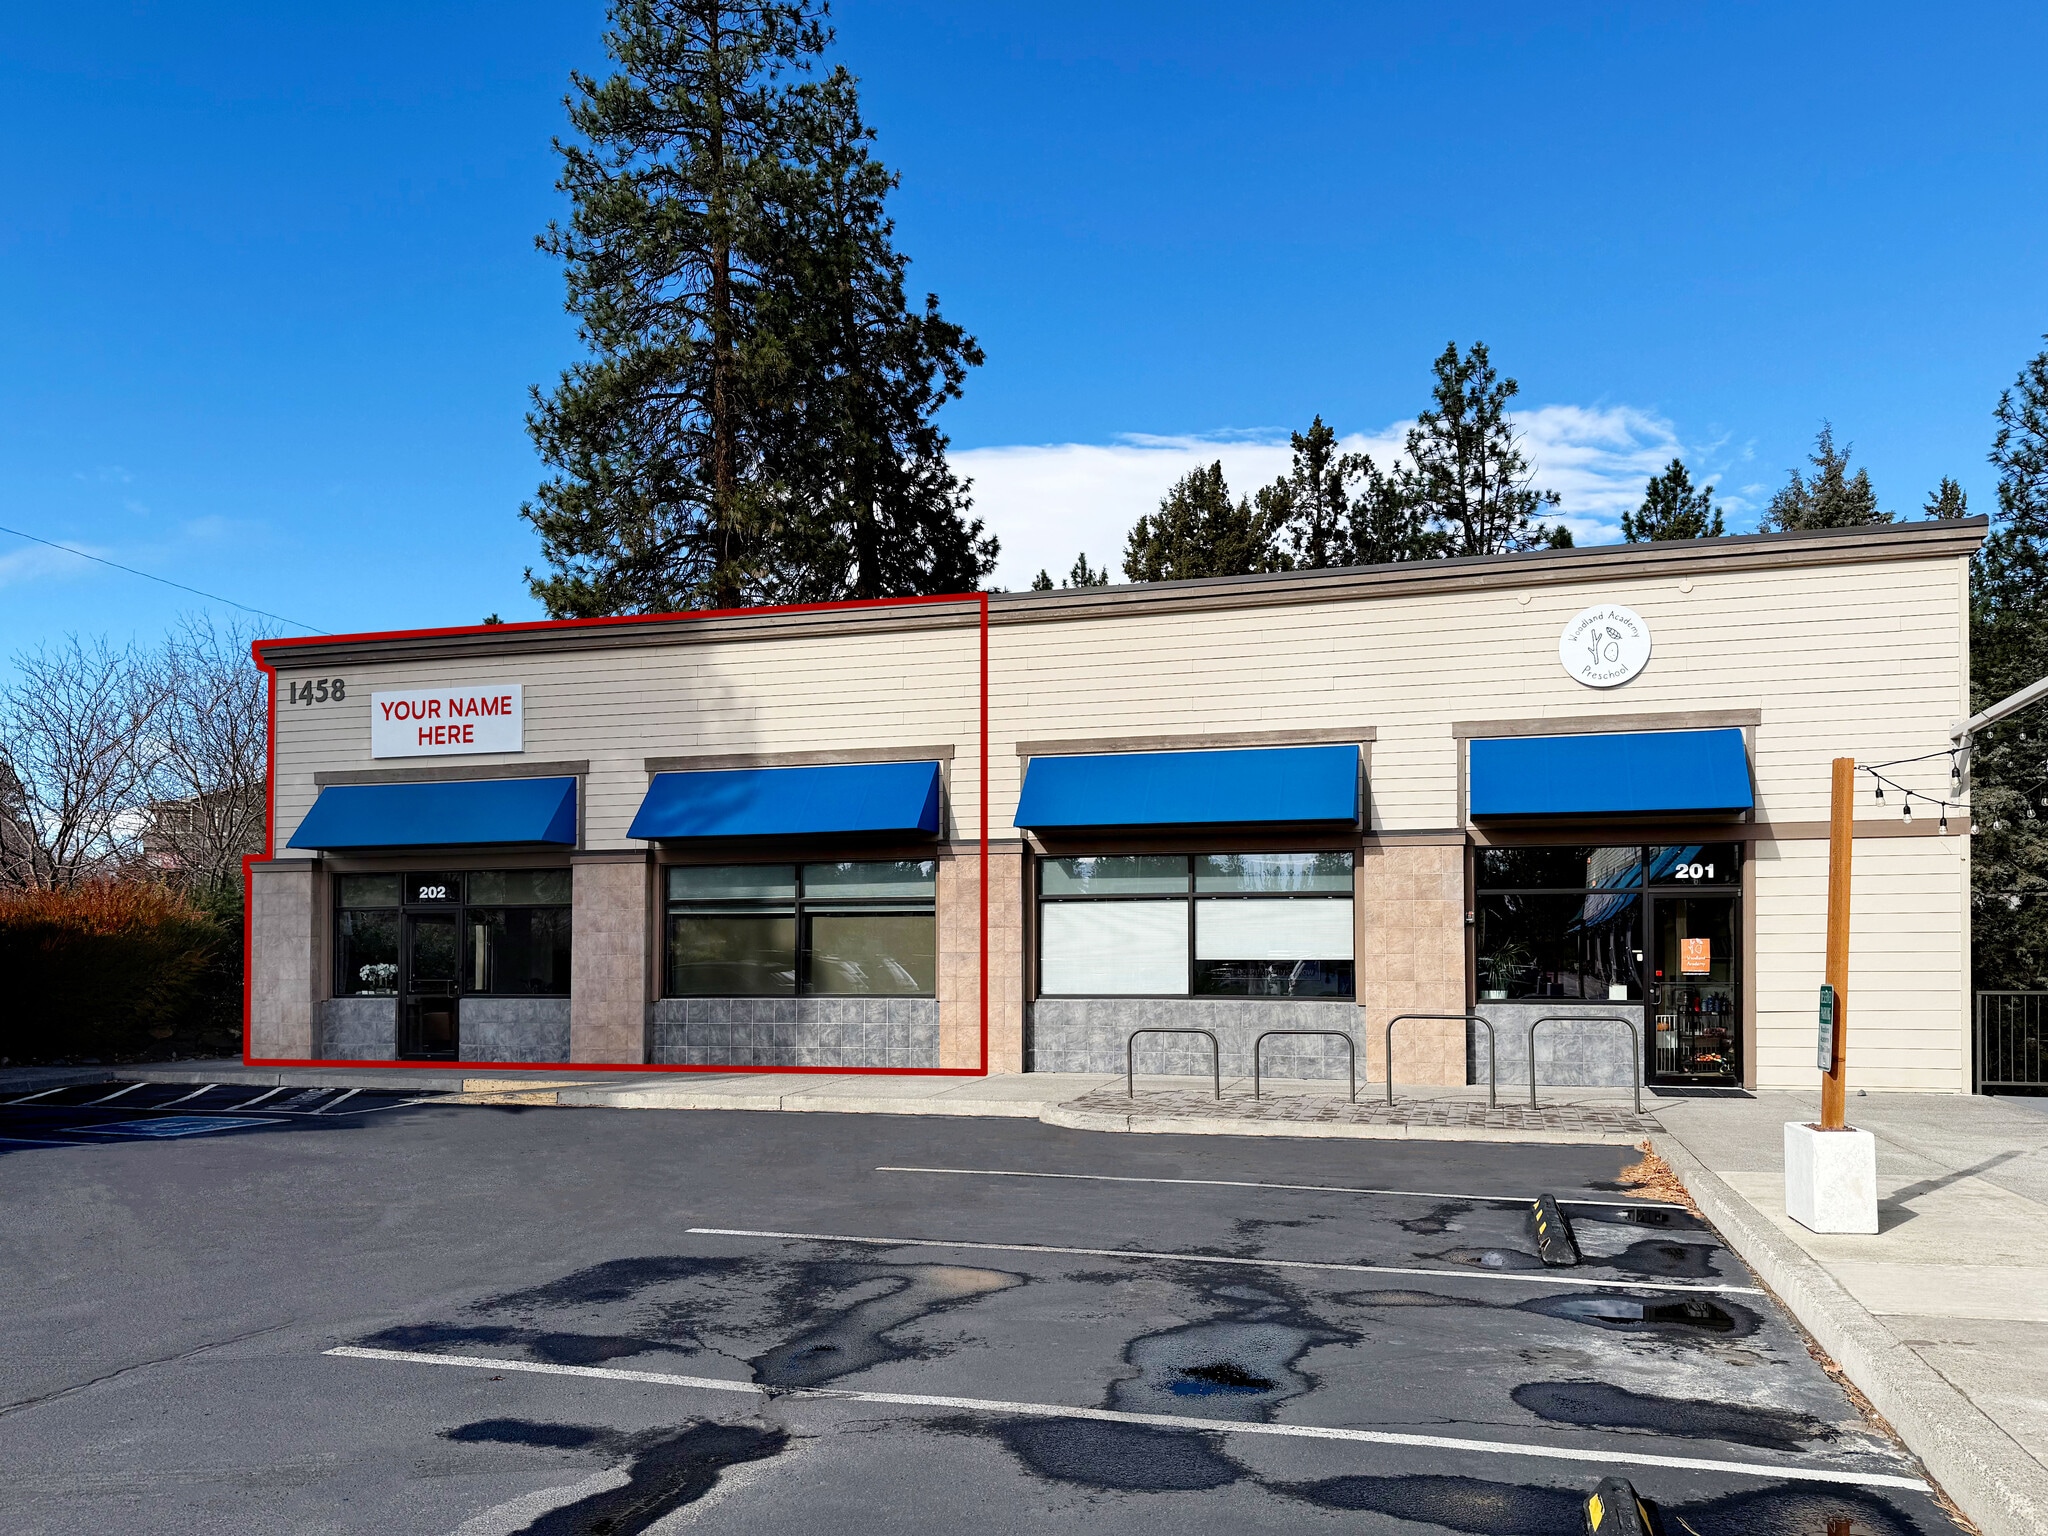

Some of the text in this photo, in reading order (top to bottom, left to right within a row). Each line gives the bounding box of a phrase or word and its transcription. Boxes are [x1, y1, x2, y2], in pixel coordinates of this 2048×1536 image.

[1568, 611, 1640, 641] Woodland Academy
[1581, 663, 1628, 680] Preschool
[290, 679, 346, 706] 1458
[381, 695, 512, 721] YOUR NAME
[418, 724, 474, 746] HERE
[1675, 863, 1714, 879] 201
[419, 886, 446, 899] 202
